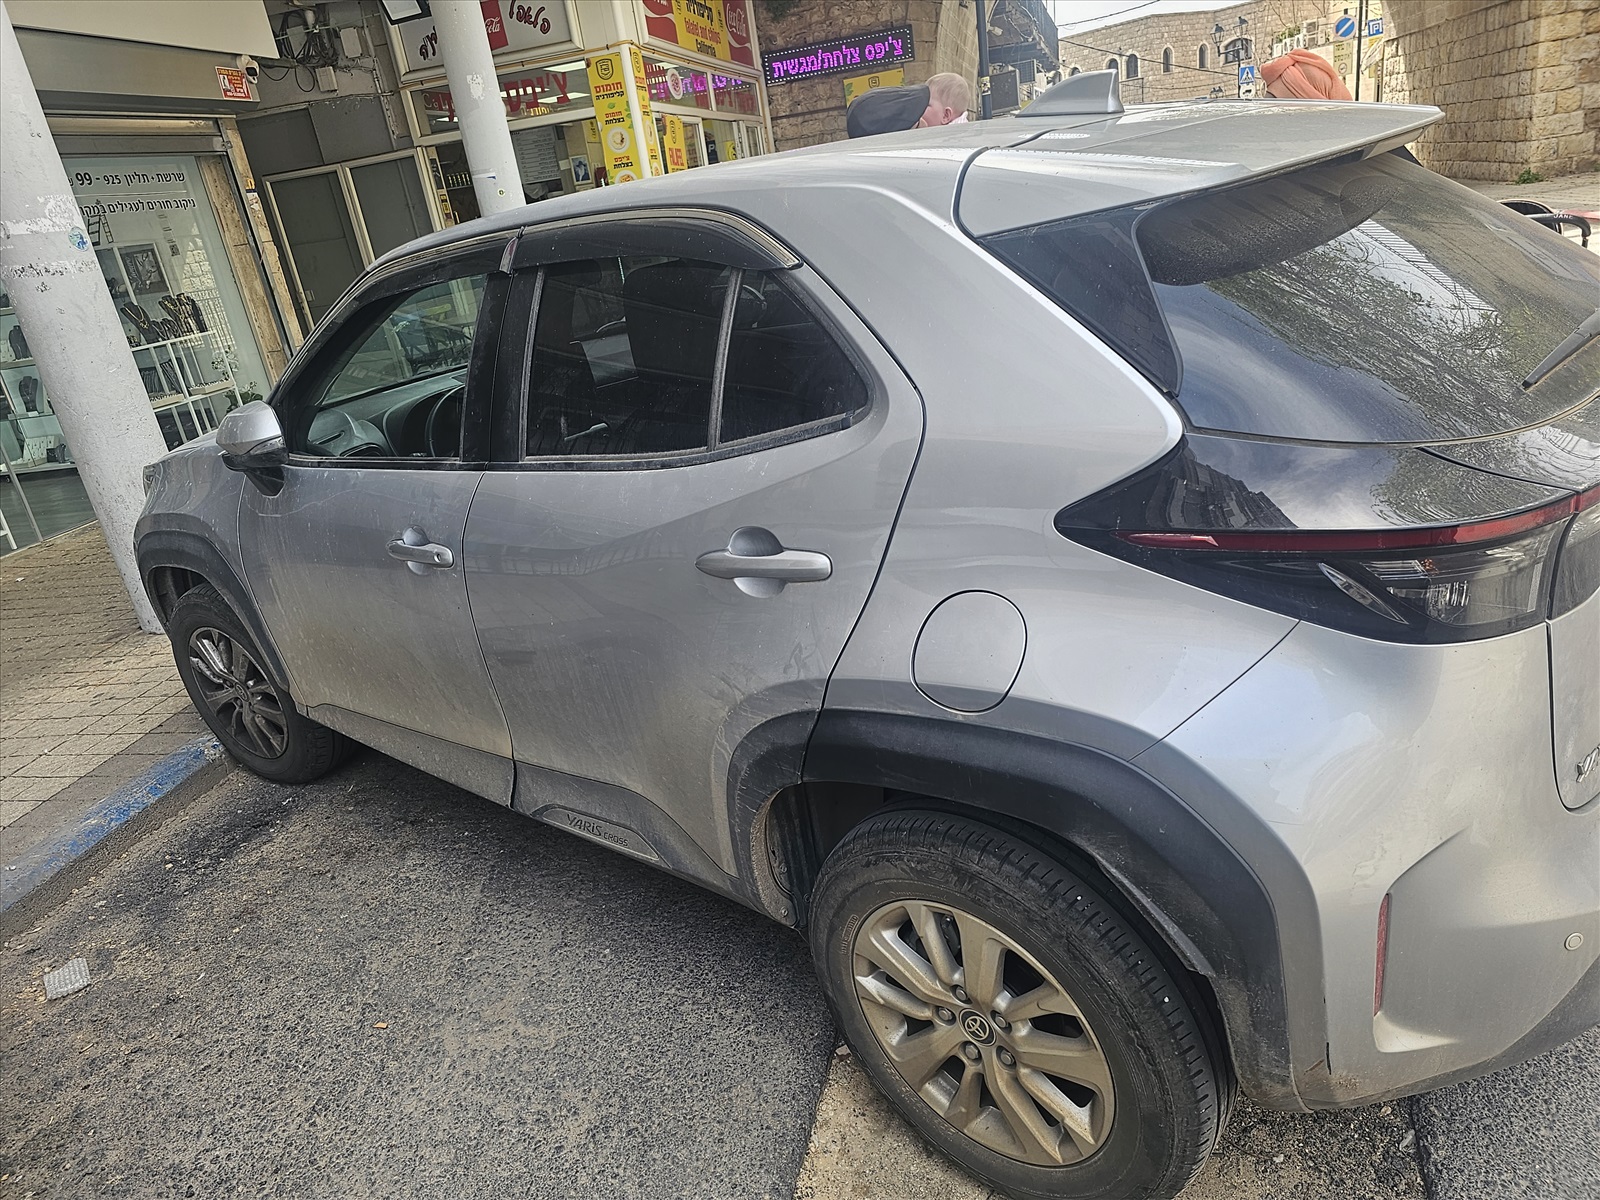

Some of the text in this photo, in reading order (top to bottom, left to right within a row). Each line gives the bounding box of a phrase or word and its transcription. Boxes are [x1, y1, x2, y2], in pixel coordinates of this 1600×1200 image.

[865, 36, 903, 60] צ'יפס
[594, 82, 623, 94] חומוס
[595, 90, 625, 101] קליפורניה
[605, 111, 622, 119] חומוס
[605, 117, 625, 125] בצלחת
[613, 161, 633, 170] בצלחת
[75, 171, 93, 186] 99
[103, 174, 122, 185] 925
[124, 171, 150, 187] תליון
[156, 171, 185, 183] שרשת
[79, 198, 196, 217] ניקוב חורים לעגילים במקו
[603, 831, 629, 847] CROSS
